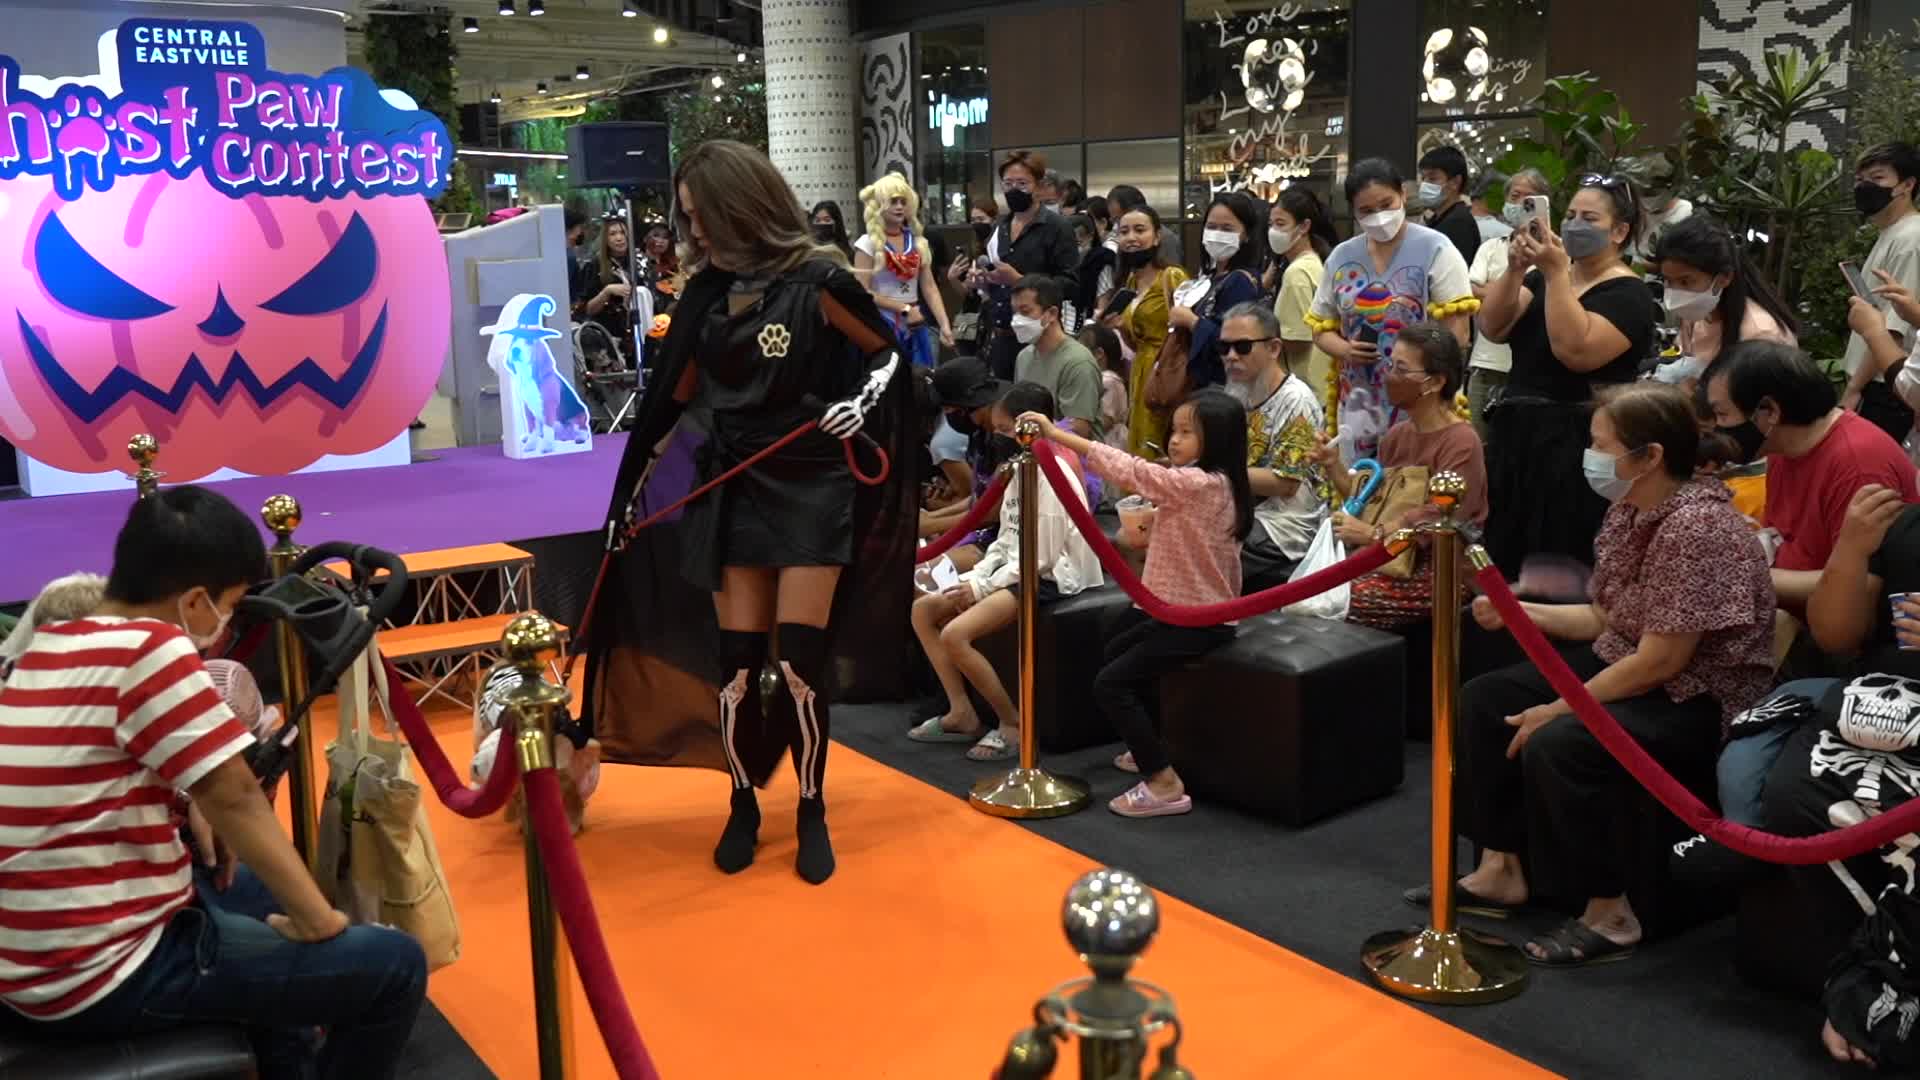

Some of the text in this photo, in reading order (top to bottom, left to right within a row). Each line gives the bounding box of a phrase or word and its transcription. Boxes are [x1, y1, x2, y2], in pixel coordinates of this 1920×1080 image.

[134, 26, 248, 47] CENTRAL
[1214, 1, 1302, 48] Love
[135, 46, 249, 66] EASTVILLE
[215, 71, 343, 131] Paw
[1220, 70, 1315, 121] Lve
[212, 131, 443, 191] Contest
